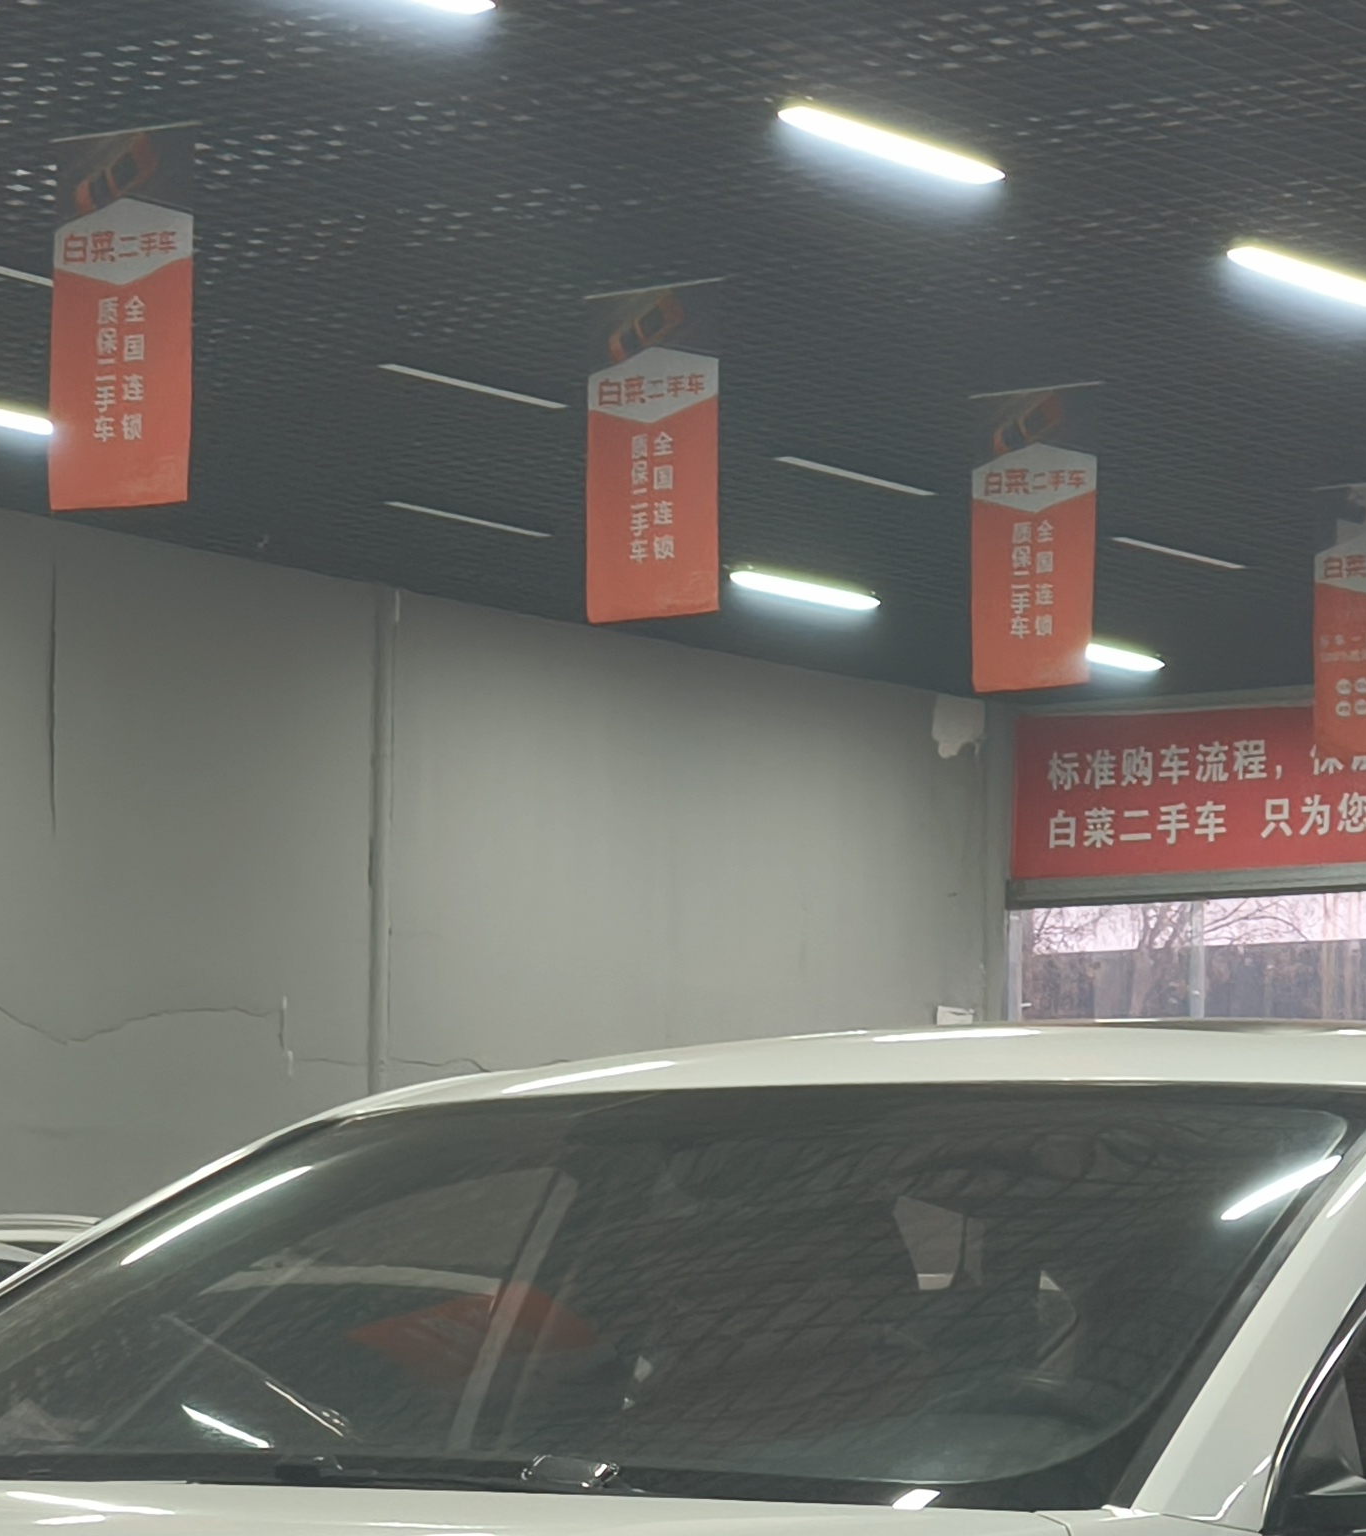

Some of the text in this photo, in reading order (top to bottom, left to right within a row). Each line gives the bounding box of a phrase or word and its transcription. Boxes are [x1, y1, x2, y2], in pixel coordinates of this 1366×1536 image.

[62, 230, 178, 265] 白菜二手车
[93, 296, 119, 442] 质保二手车
[121, 295, 146, 440] 全国连锁
[597, 373, 705, 406] 白菜二手车
[630, 434, 649, 563] 质保二手车
[1049, 801, 1227, 848] 白菜二手车
